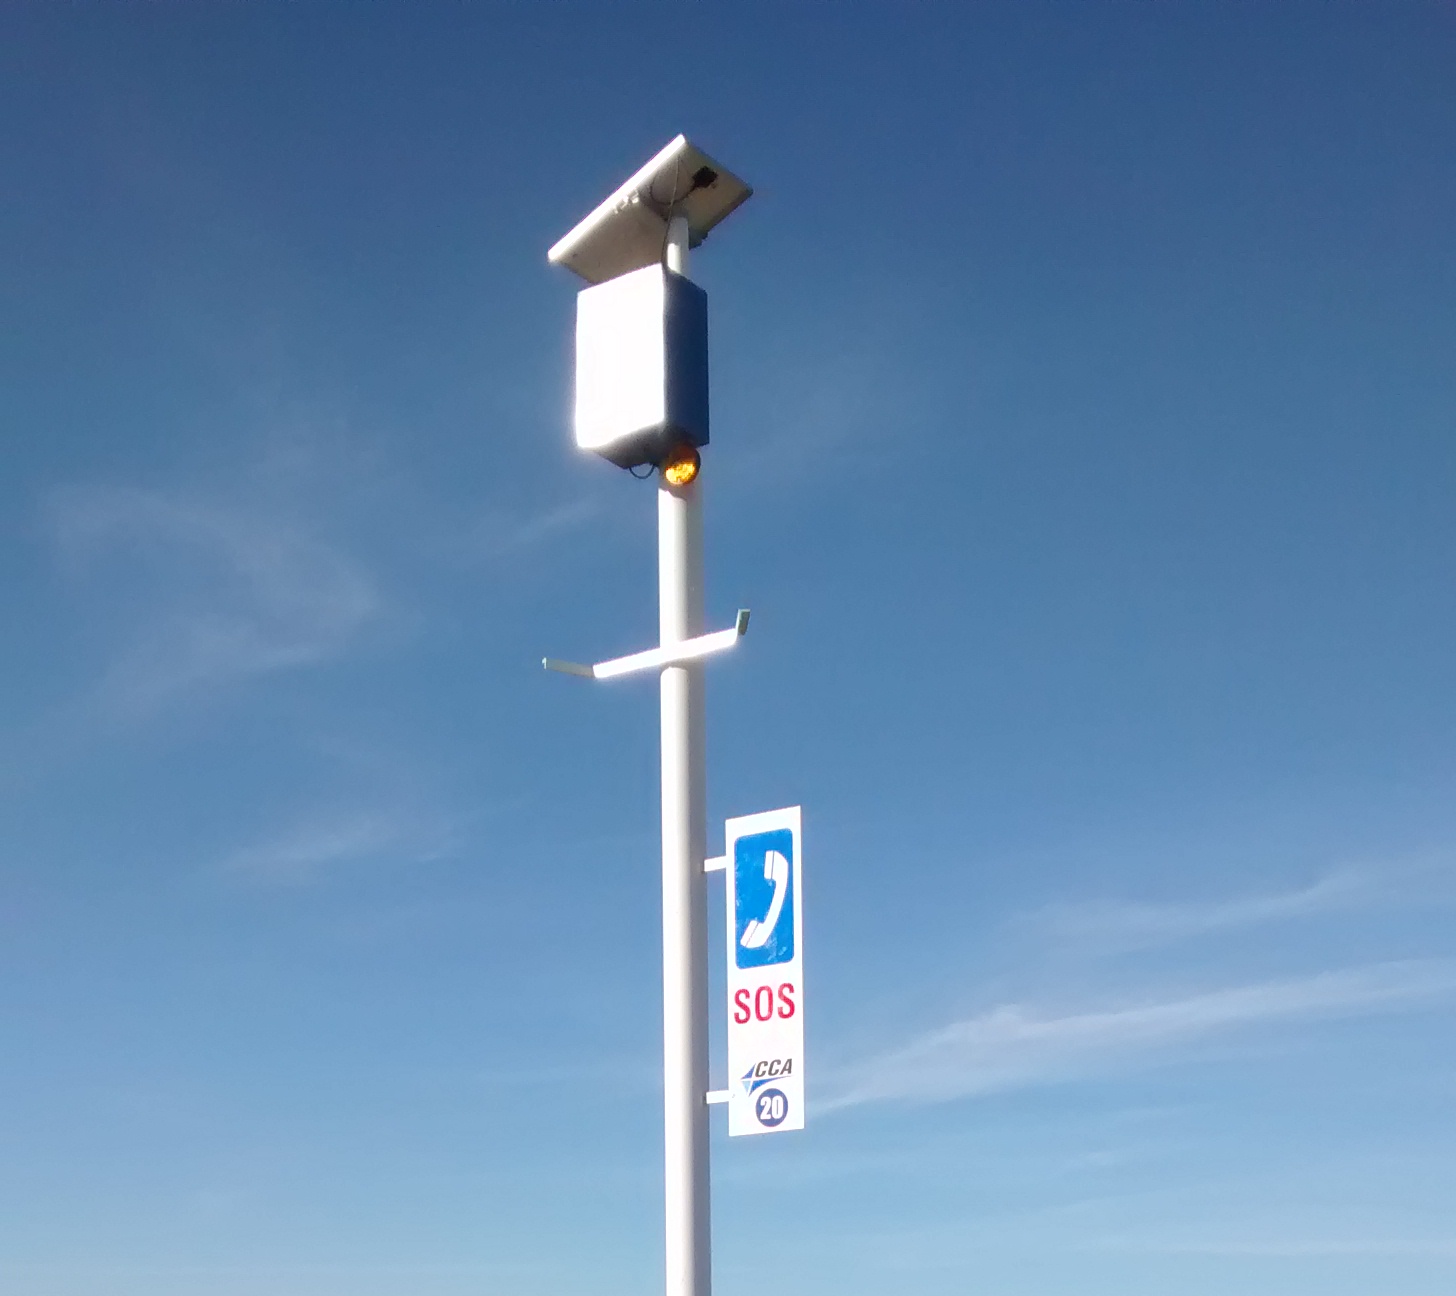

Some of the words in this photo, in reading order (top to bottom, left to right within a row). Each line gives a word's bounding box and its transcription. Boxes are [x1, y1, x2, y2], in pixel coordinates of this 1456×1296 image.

[734, 983, 795, 1024] SOS
[755, 1058, 793, 1078] CCA
[760, 1095, 783, 1120] 20
